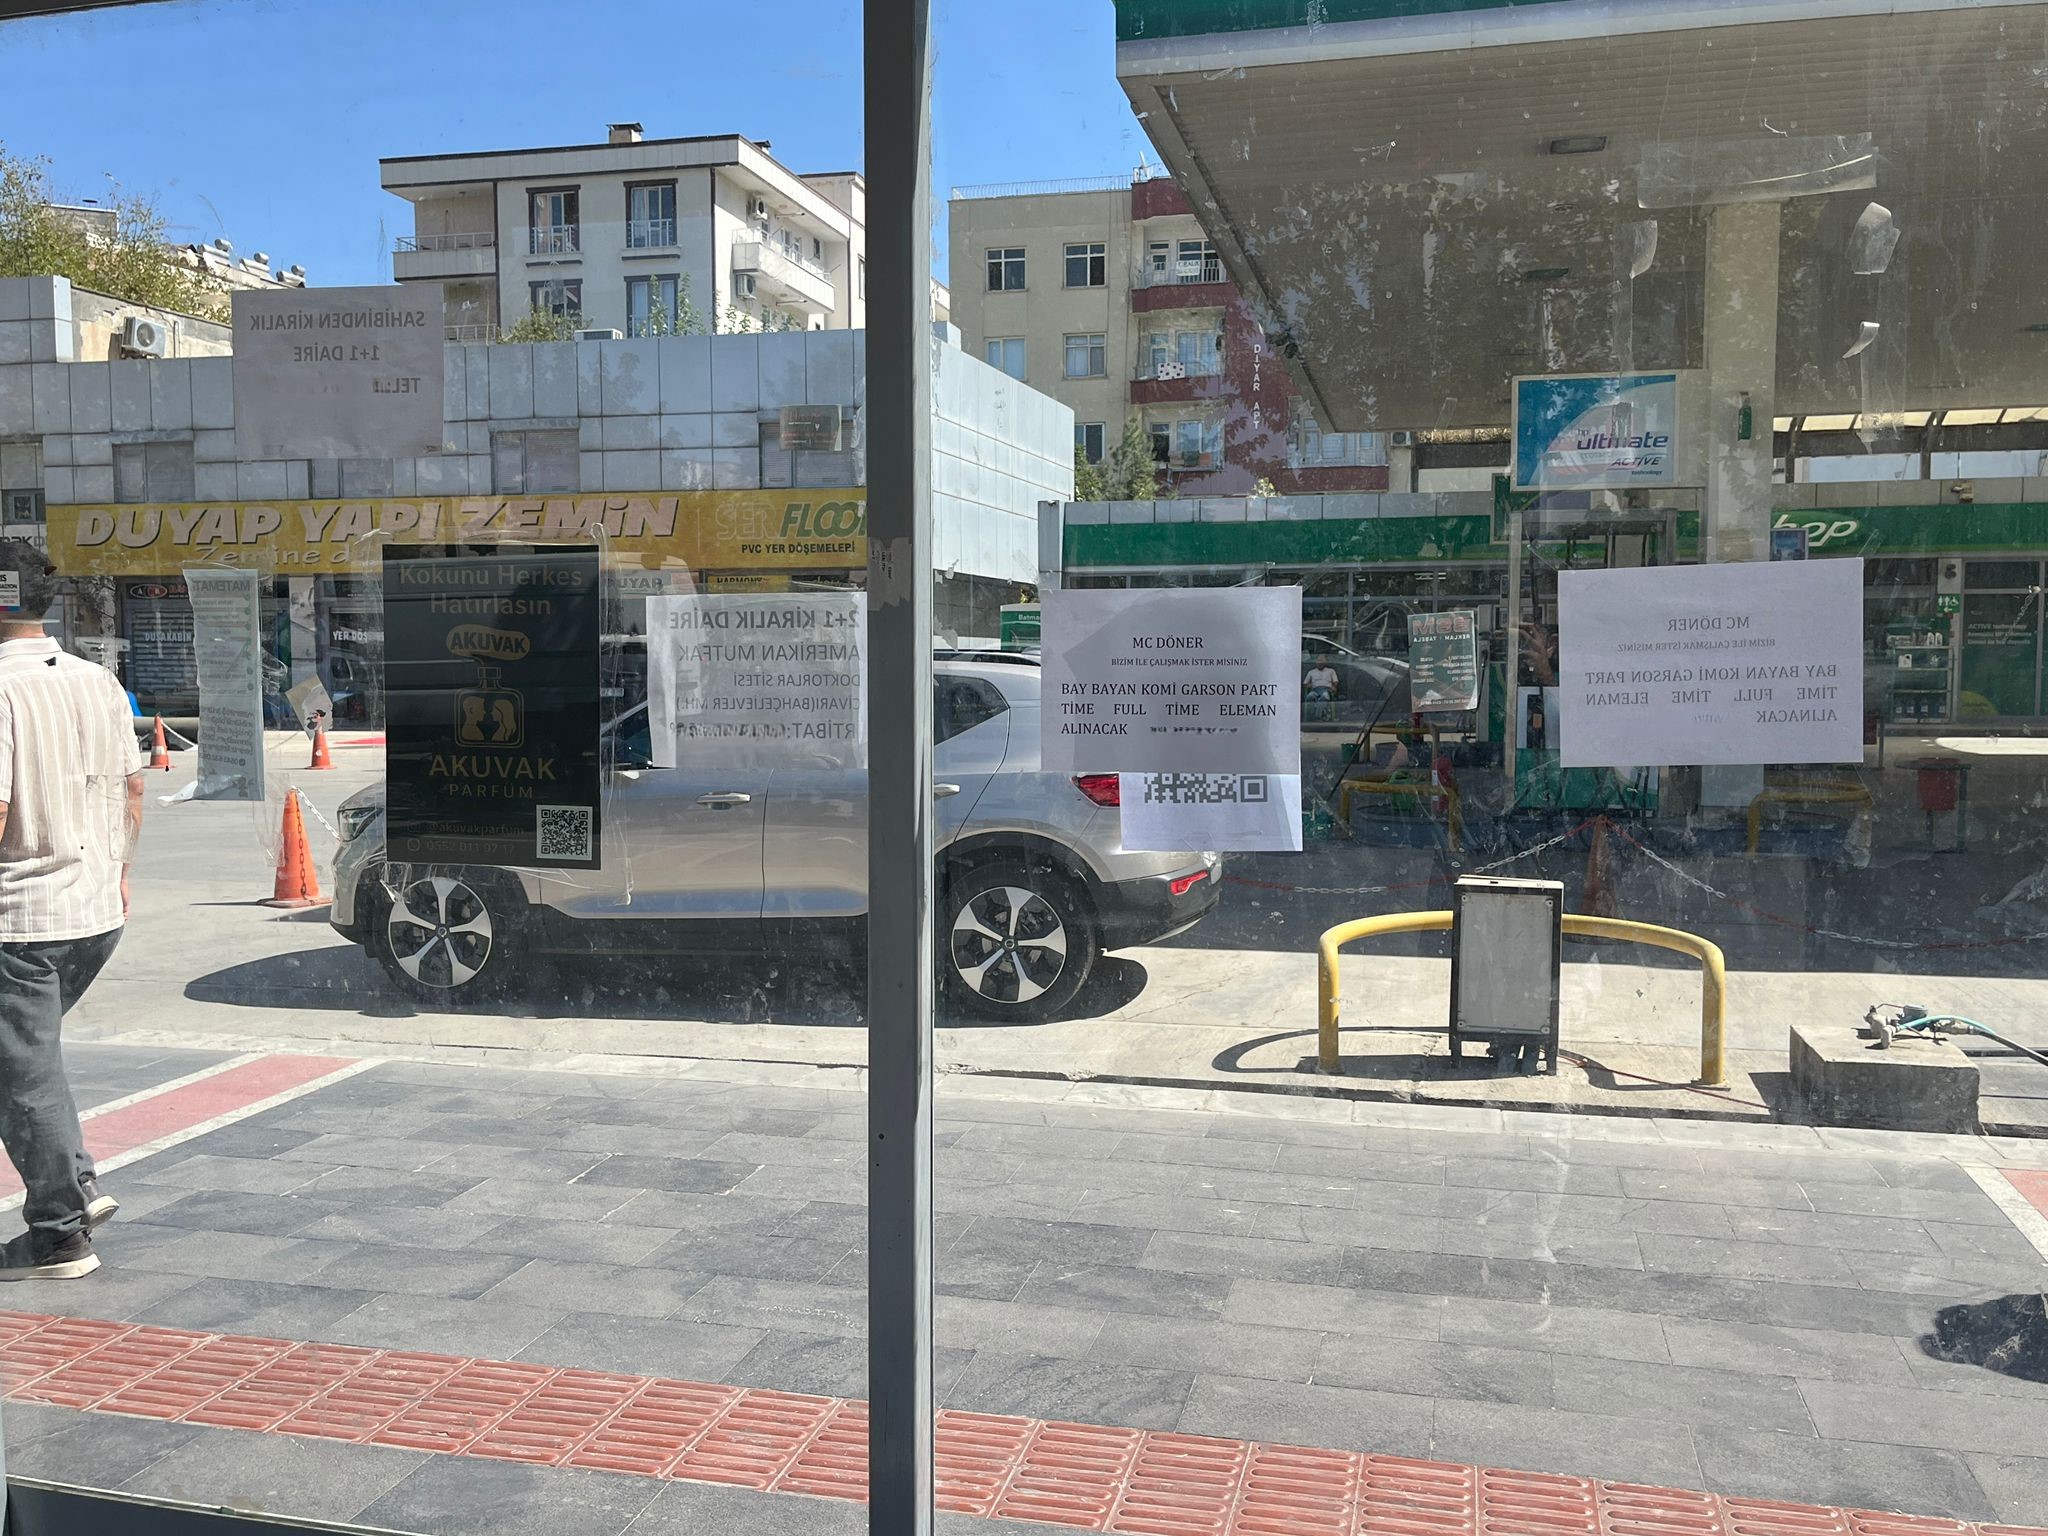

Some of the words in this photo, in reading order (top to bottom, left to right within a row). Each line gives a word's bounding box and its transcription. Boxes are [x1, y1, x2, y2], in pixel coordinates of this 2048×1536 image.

[1253, 402, 1261, 430] APT
[1611, 456, 1662, 467] ACTIVE
[76, 505, 281, 549] DUYAP
[297, 502, 441, 543] YAPI
[742, 543, 762, 554] PVC
[765, 543, 786, 554] YER
[400, 564, 489, 586] Kokunu
[498, 564, 582, 587] Herkes
[430, 592, 551, 616] Hatırlasın
[451, 630, 527, 655] AKUVAK
[1132, 637, 1153, 649] MC
[1156, 634, 1204, 649] DÖNER
[1111, 657, 1134, 667] BİZİM
[1135, 657, 1148, 667] İLE
[1149, 657, 1190, 668] ÇALIŞMAK
[1191, 658, 1215, 667] İSTER
[1061, 683, 1088, 695] BAY
[1091, 683, 1136, 696] BAYAN
[1141, 681, 1176, 696] KOMİ
[1181, 683, 1236, 697] GARSON
[1240, 684, 1278, 697] PART
[1061, 701, 1095, 715] TİME
[1113, 703, 1147, 716] FULL
[1165, 701, 1200, 716] TİME
[1219, 704, 1277, 717] ELEMAN
[1061, 723, 1128, 735] ALINACAK
[429, 754, 556, 781] AKUVAK
[450, 782, 533, 799] PARFÜM
